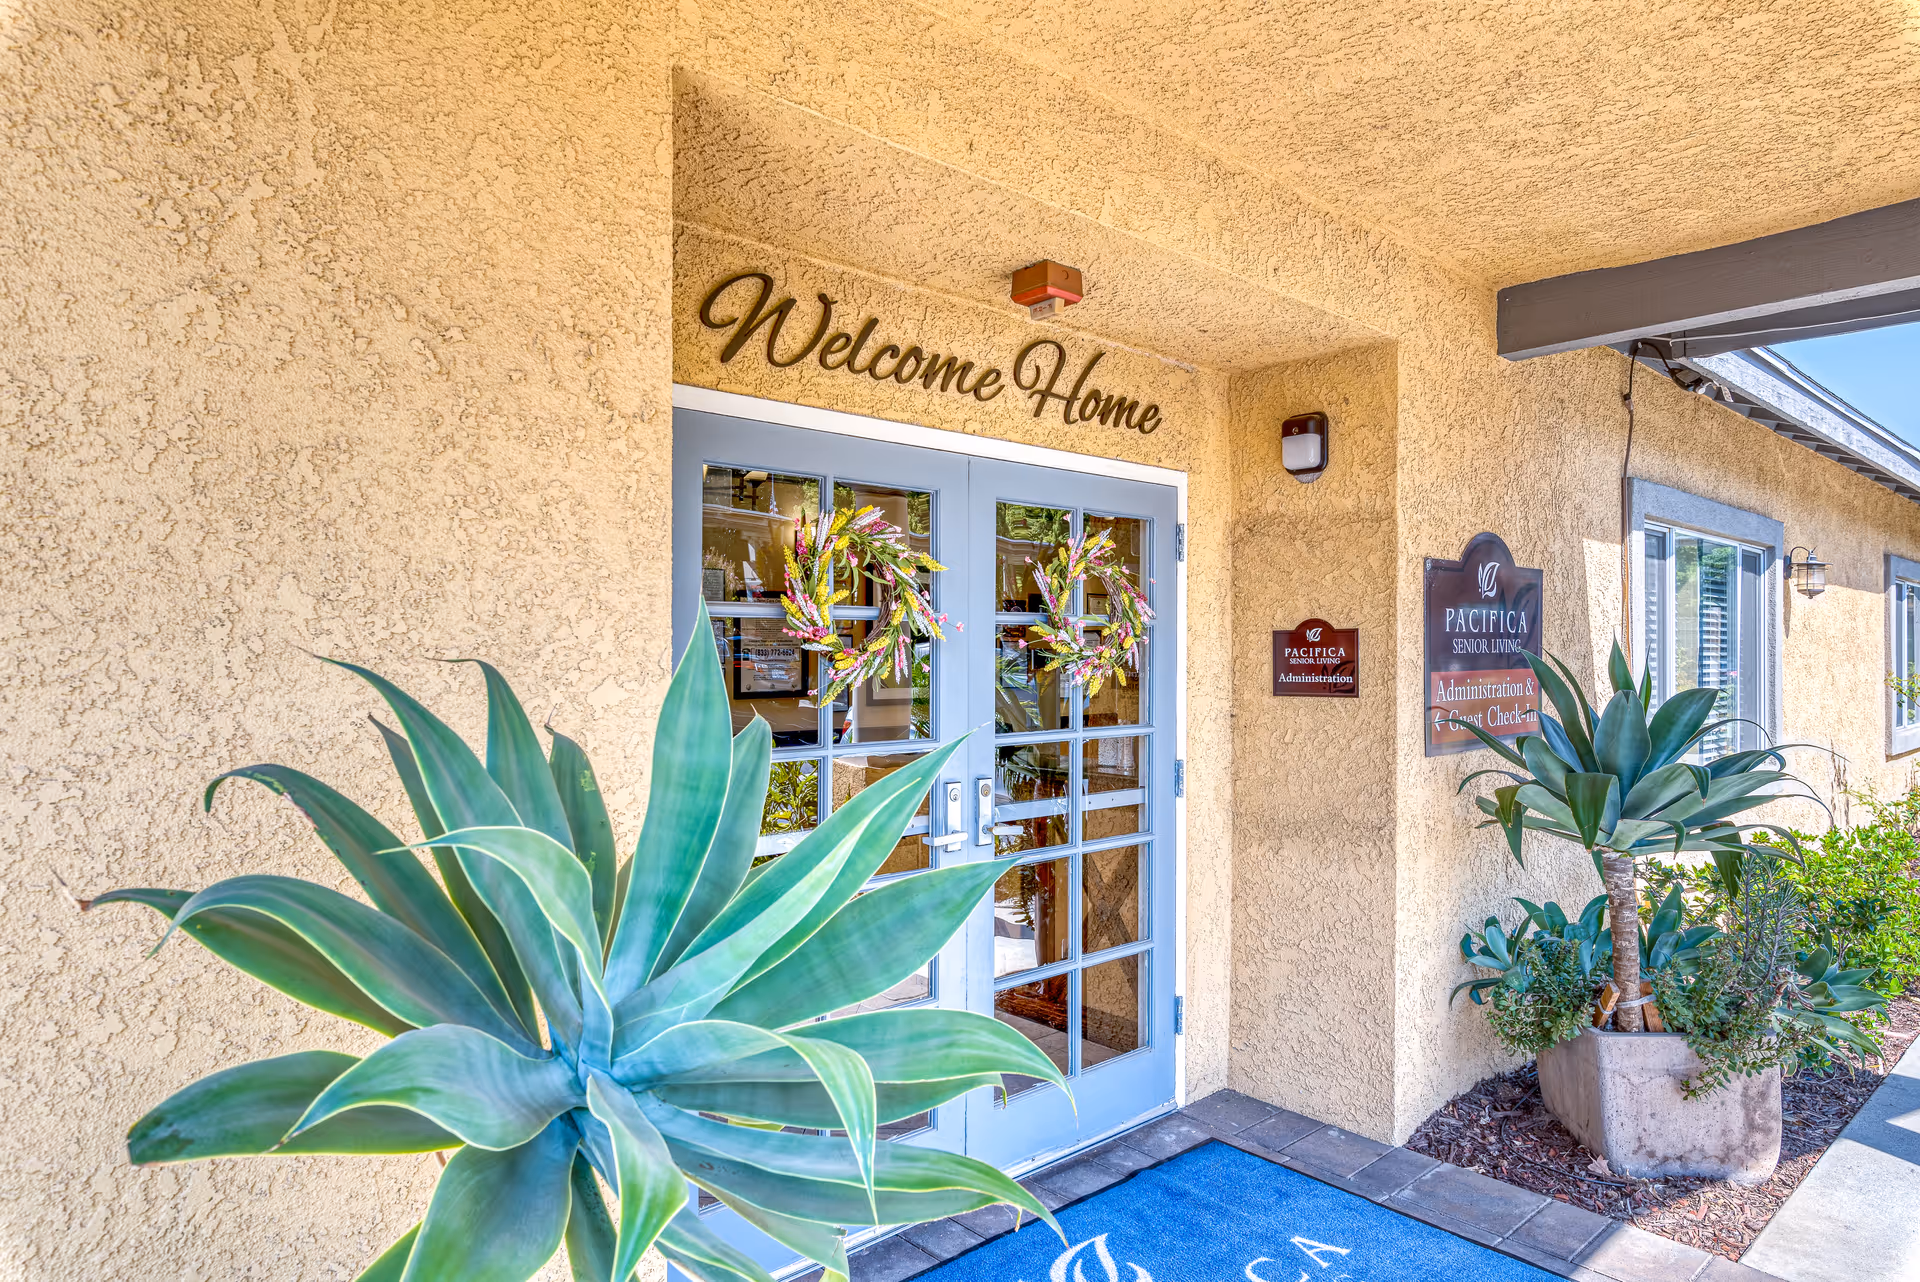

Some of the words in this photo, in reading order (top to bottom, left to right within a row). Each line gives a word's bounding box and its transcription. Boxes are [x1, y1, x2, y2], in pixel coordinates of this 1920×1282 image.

[699, 272, 1005, 402] Welcome
[1013, 338, 1163, 434] Home
[1445, 608, 1527, 633] PACIFICA
[1285, 648, 1346, 657] PACIFICA
[1453, 638, 1489, 654] SENIOR
[1491, 638, 1521, 654] LIVING
[1278, 673, 1353, 683] Administration
[1436, 676, 1523, 702] Administration
[1525, 677, 1534, 696] &
